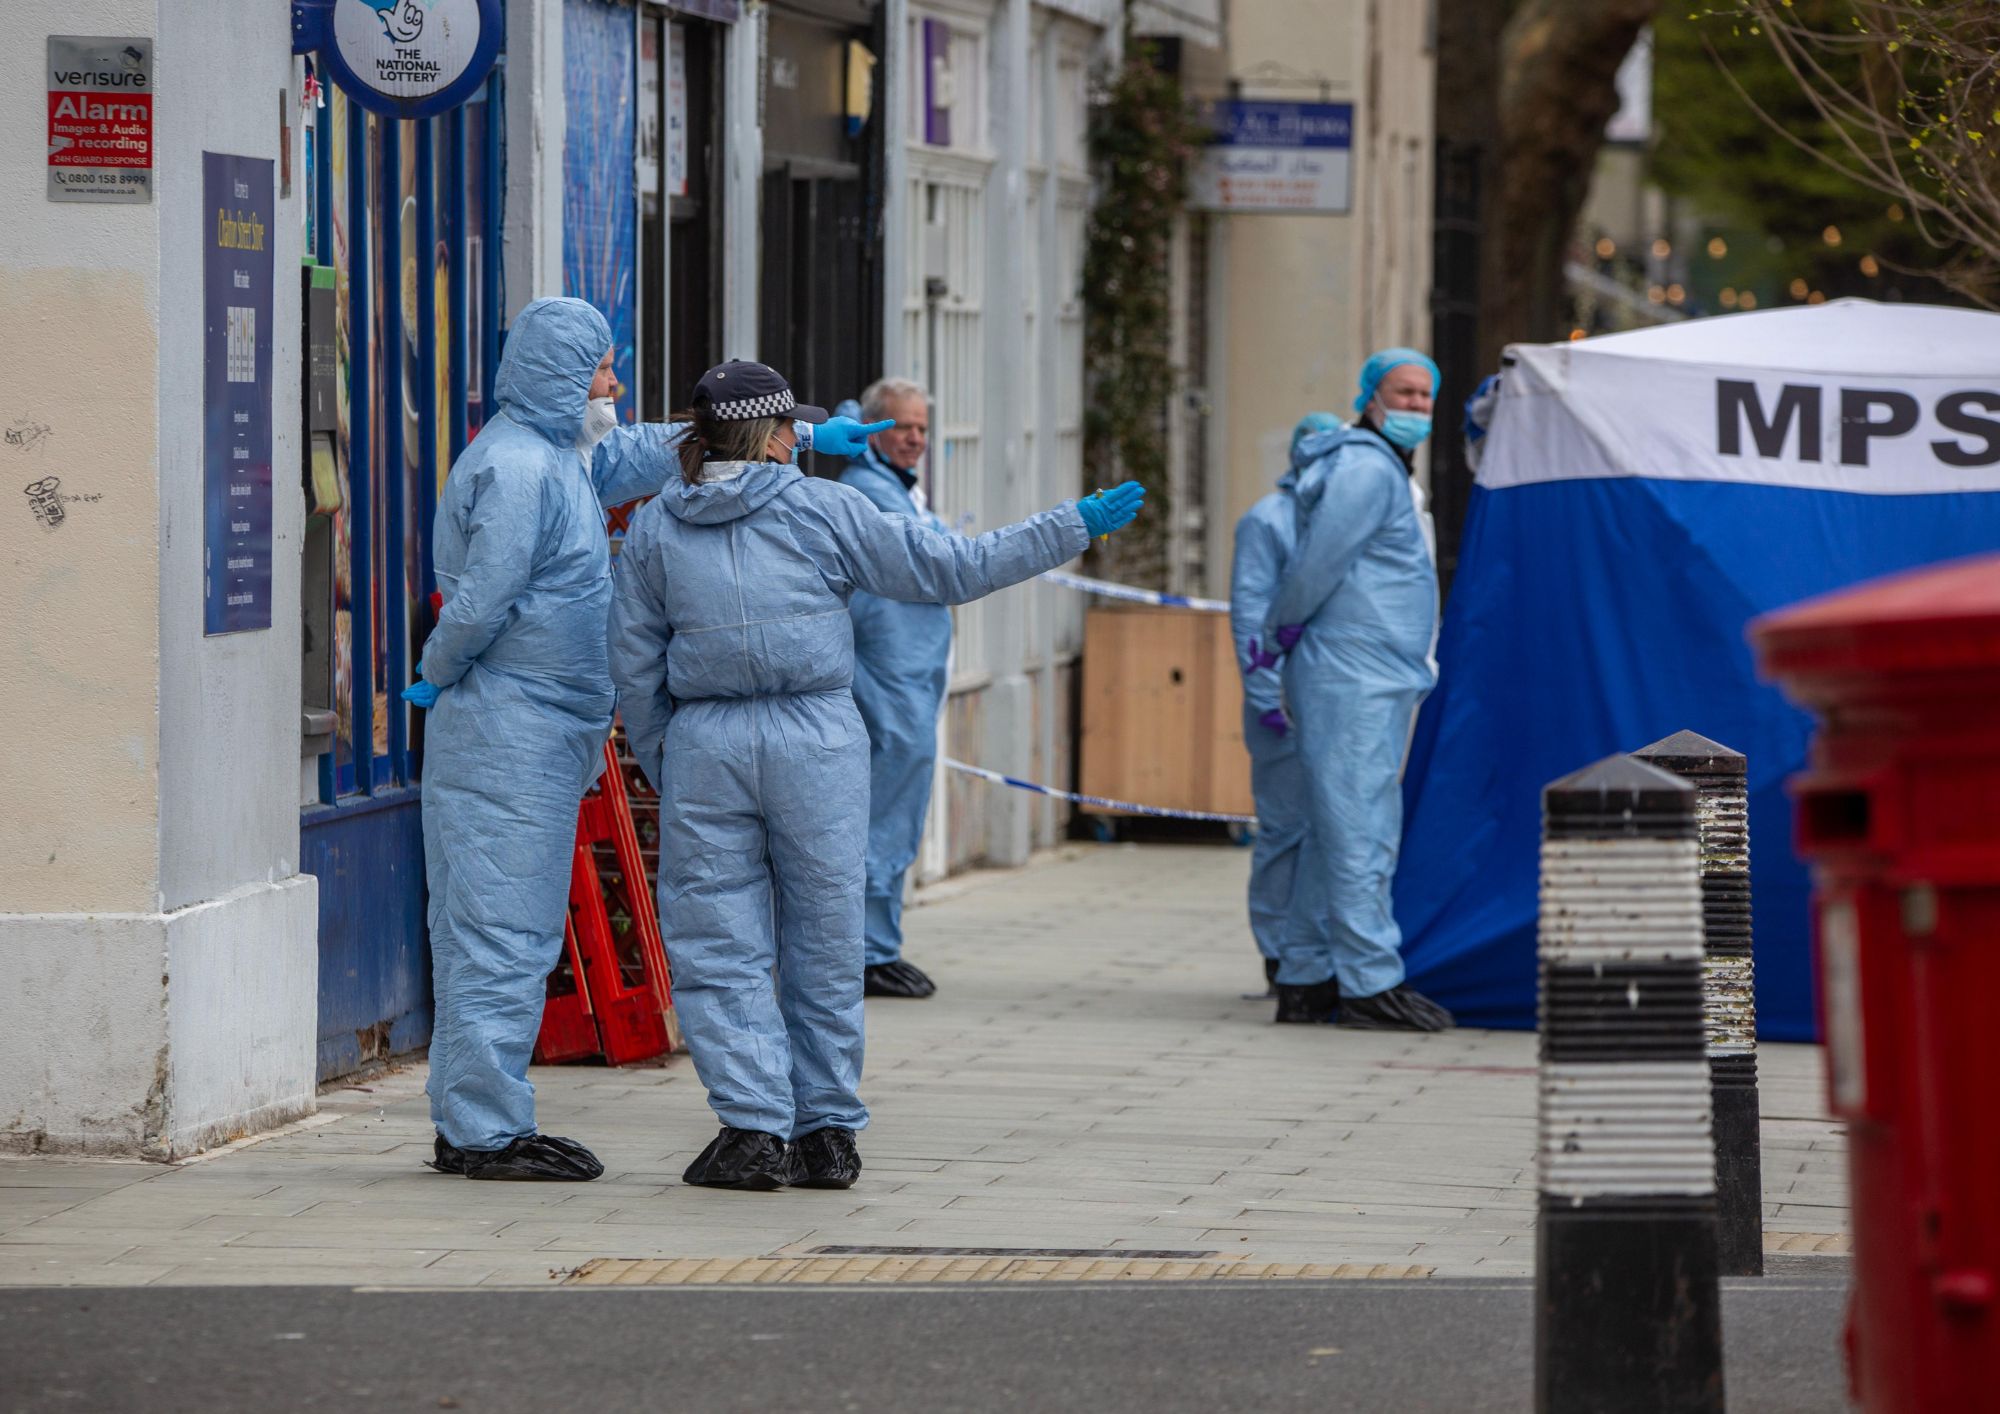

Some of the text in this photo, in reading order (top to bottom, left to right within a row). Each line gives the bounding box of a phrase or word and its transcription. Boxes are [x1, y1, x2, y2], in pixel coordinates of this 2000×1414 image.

[395, 49, 421, 60] THE
[376, 59, 440, 71] NATIONAL
[54, 71, 146, 87] verisure
[380, 71, 437, 82] LOTTERY
[54, 96, 148, 121] Alarm
[54, 122, 147, 136] Images & Audio
[78, 137, 148, 153] recording
[54, 155, 147, 165] 24H GUARD RESPONSE
[68, 174, 146, 185] 0800 158 8999
[64, 186, 136, 195] www.verisure.co.uk
[1715, 377, 2000, 469] MPS
